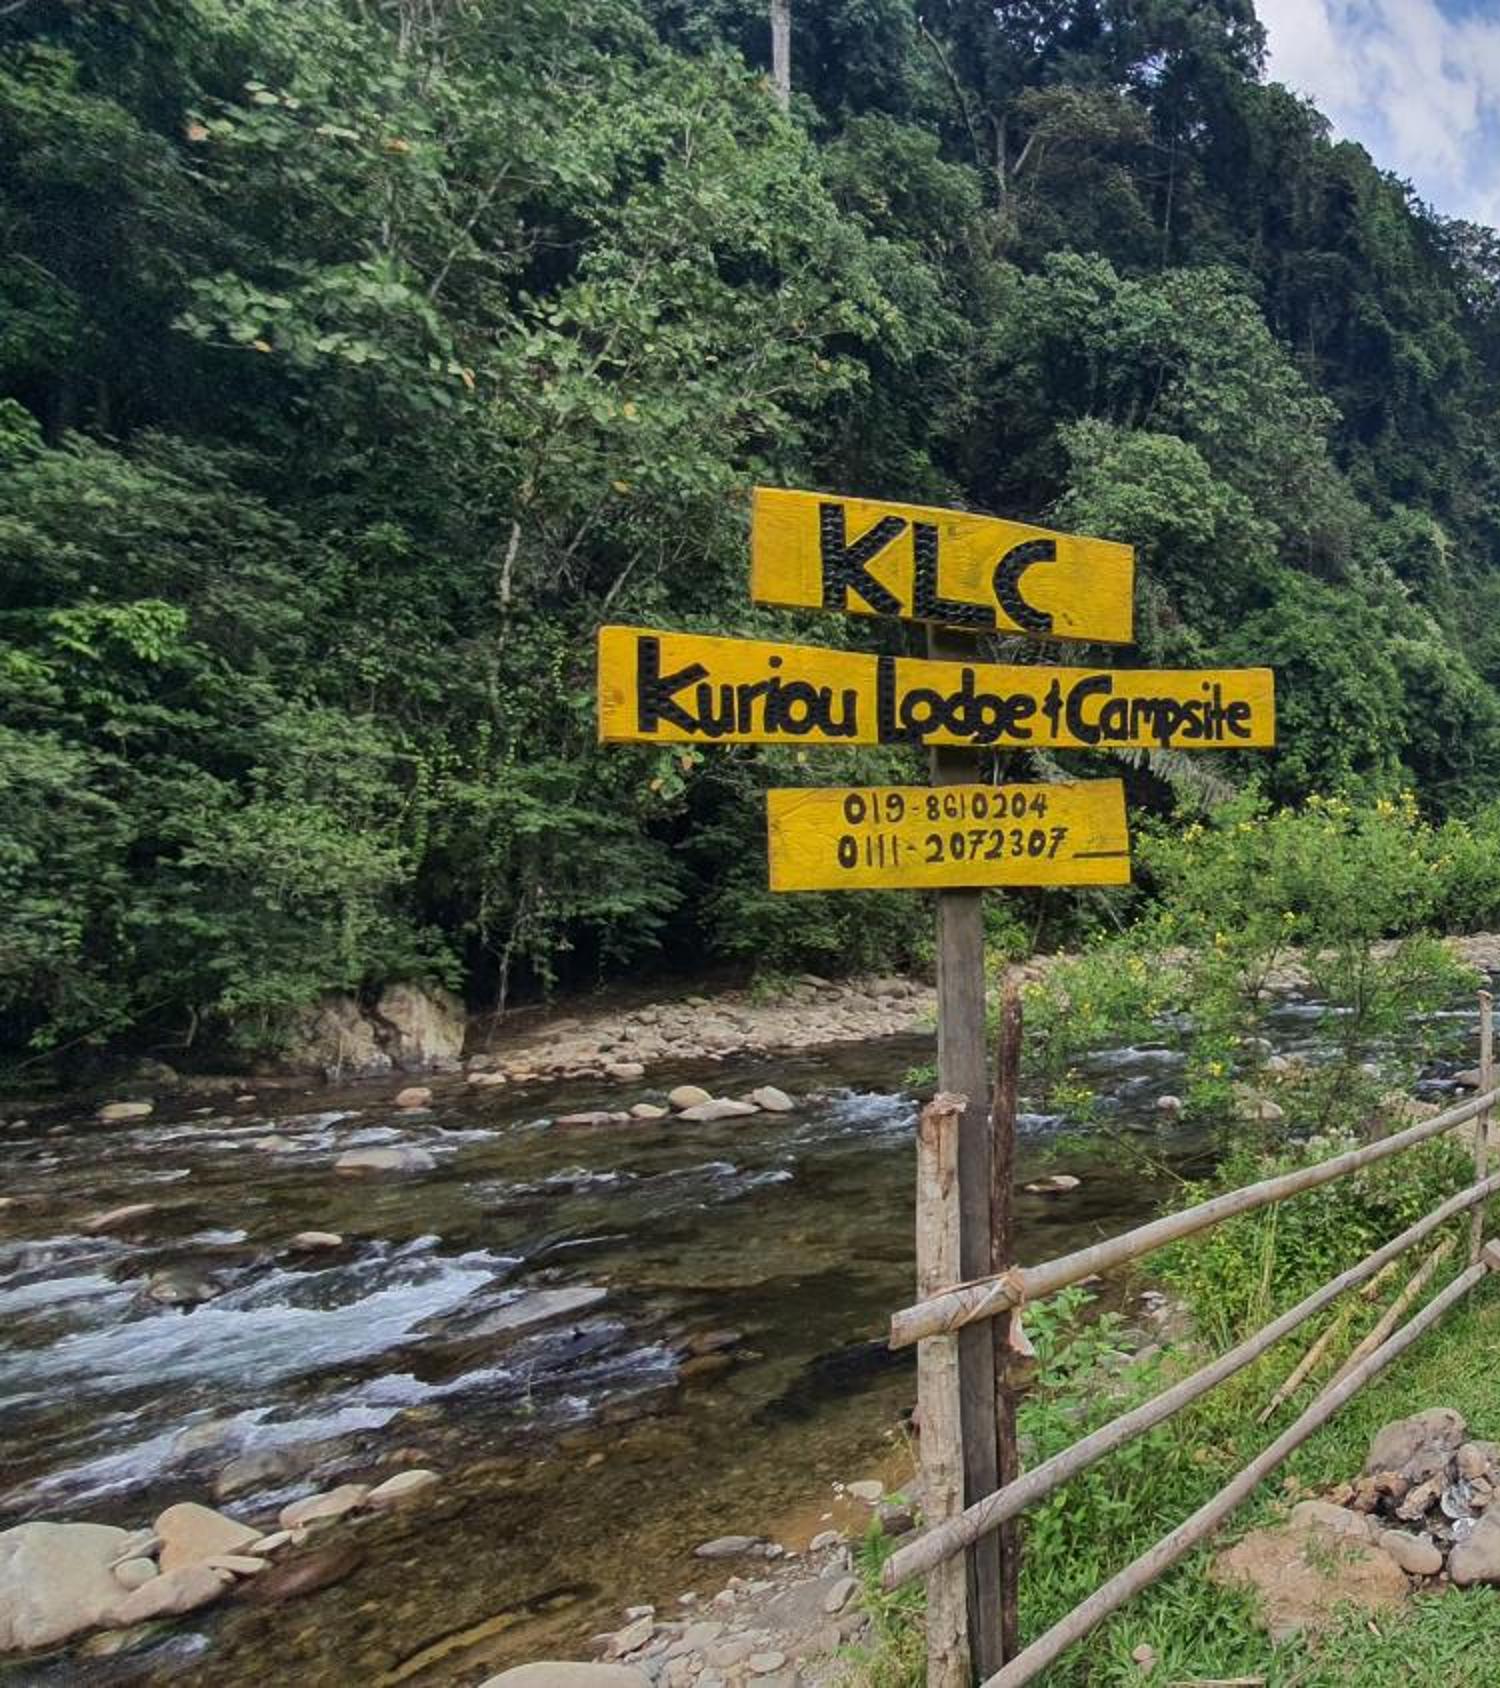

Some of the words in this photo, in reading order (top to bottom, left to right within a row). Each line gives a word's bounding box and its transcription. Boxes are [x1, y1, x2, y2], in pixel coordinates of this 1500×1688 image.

[819, 502, 1057, 633] KLC
[637, 635, 858, 738] Kuriou
[876, 656, 1037, 744] Lodge
[1065, 675, 1253, 748] Campsite
